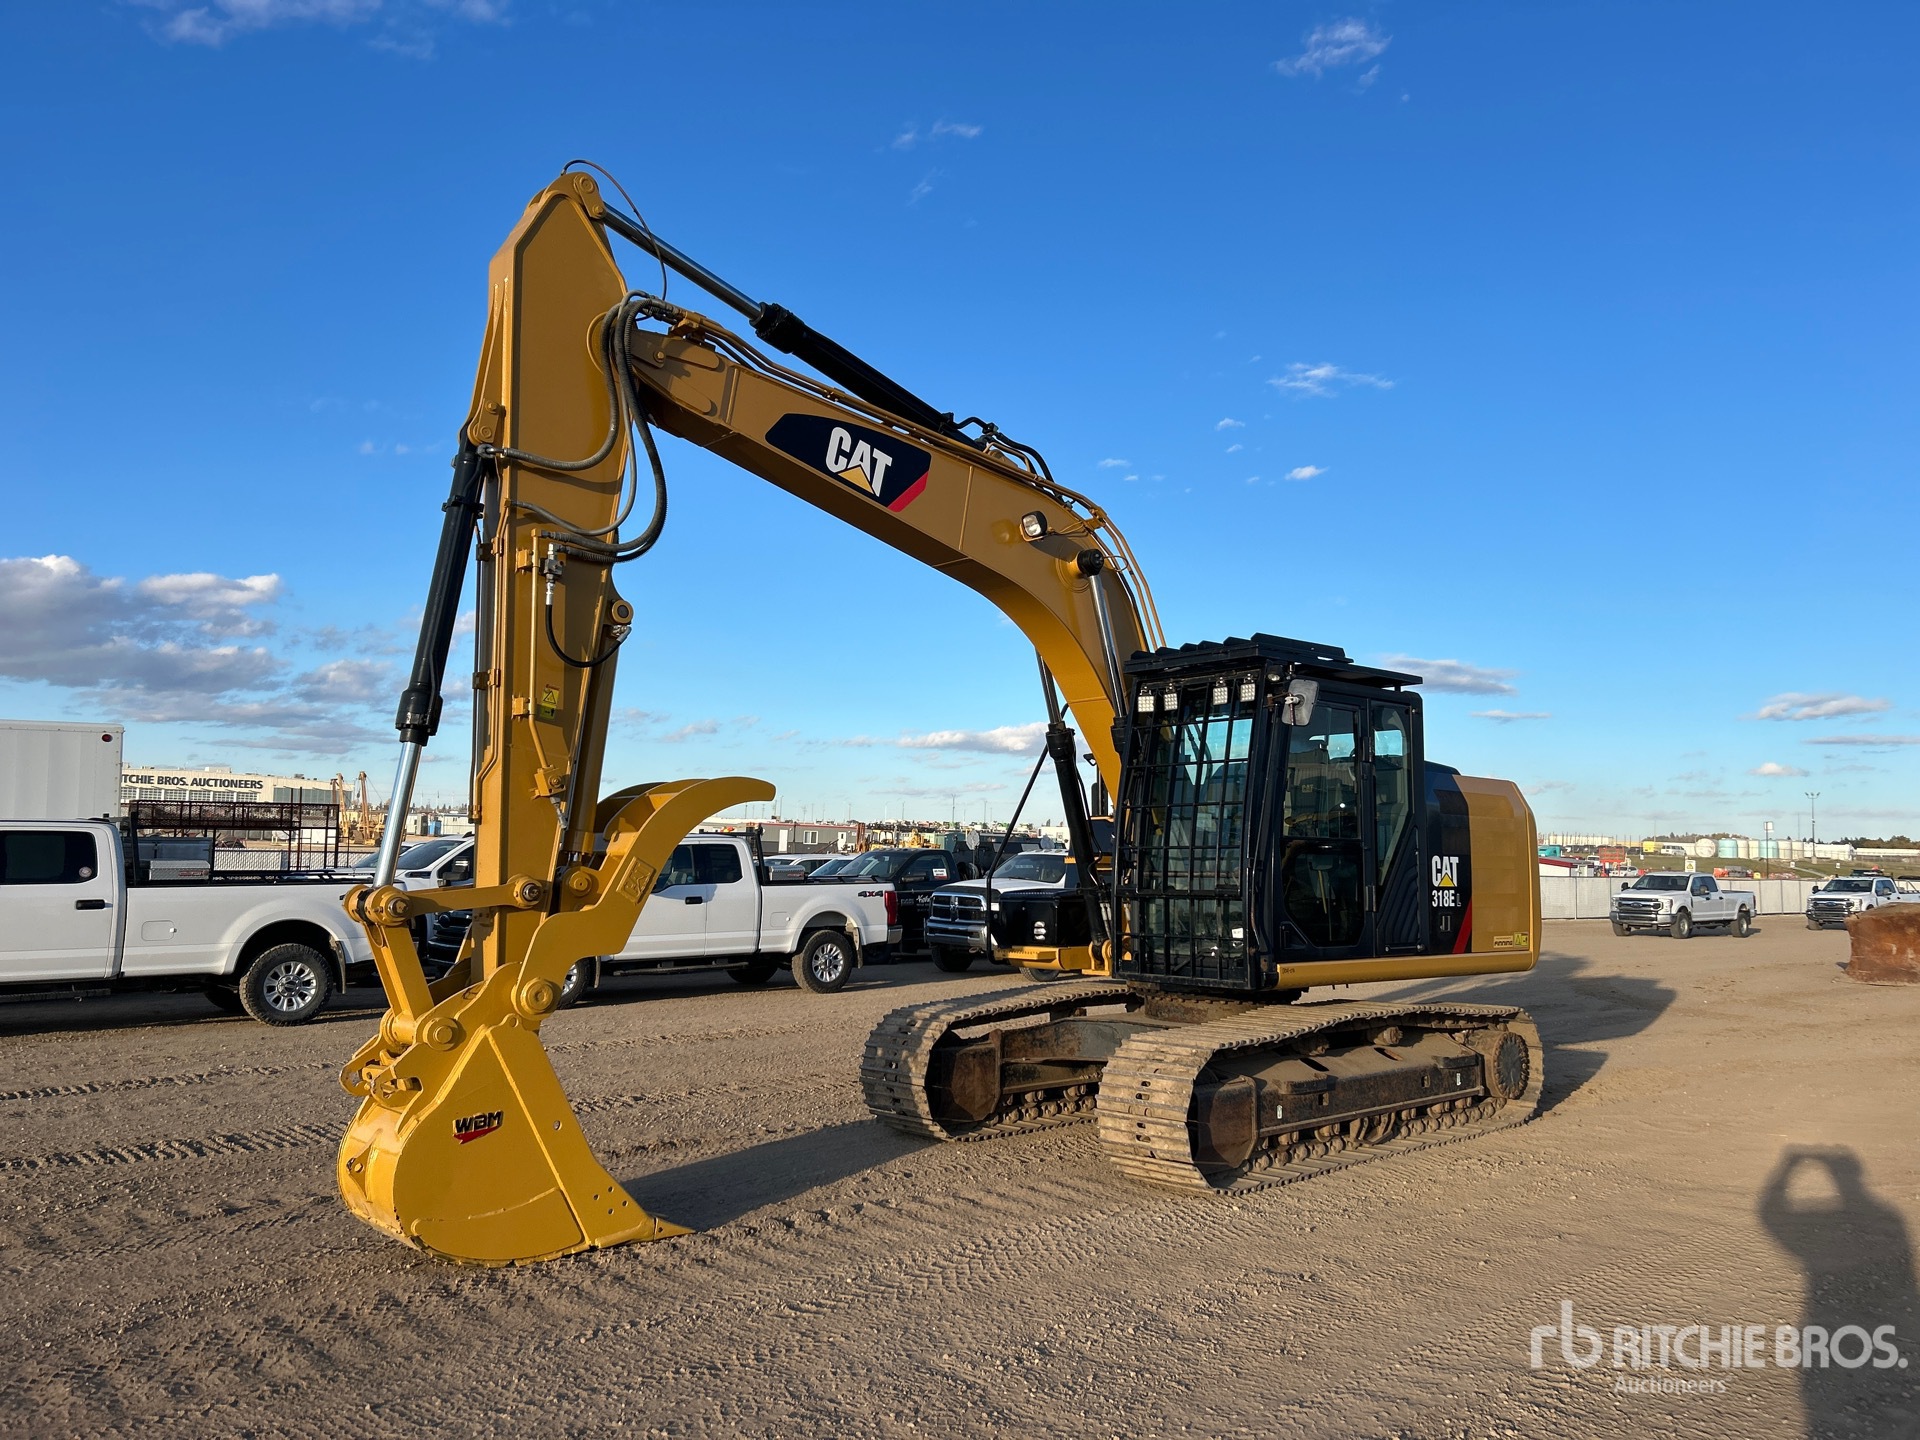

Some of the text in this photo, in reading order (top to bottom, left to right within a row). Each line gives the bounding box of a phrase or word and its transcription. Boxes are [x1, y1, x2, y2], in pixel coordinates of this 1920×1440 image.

[826, 427, 892, 497] CAT
[122, 774, 263, 789] TCHIE BROS. AUCTIONEERS
[1431, 855, 1459, 887] CAT
[1431, 889, 1455, 907] 318E
[453, 1110, 504, 1134] WBM
